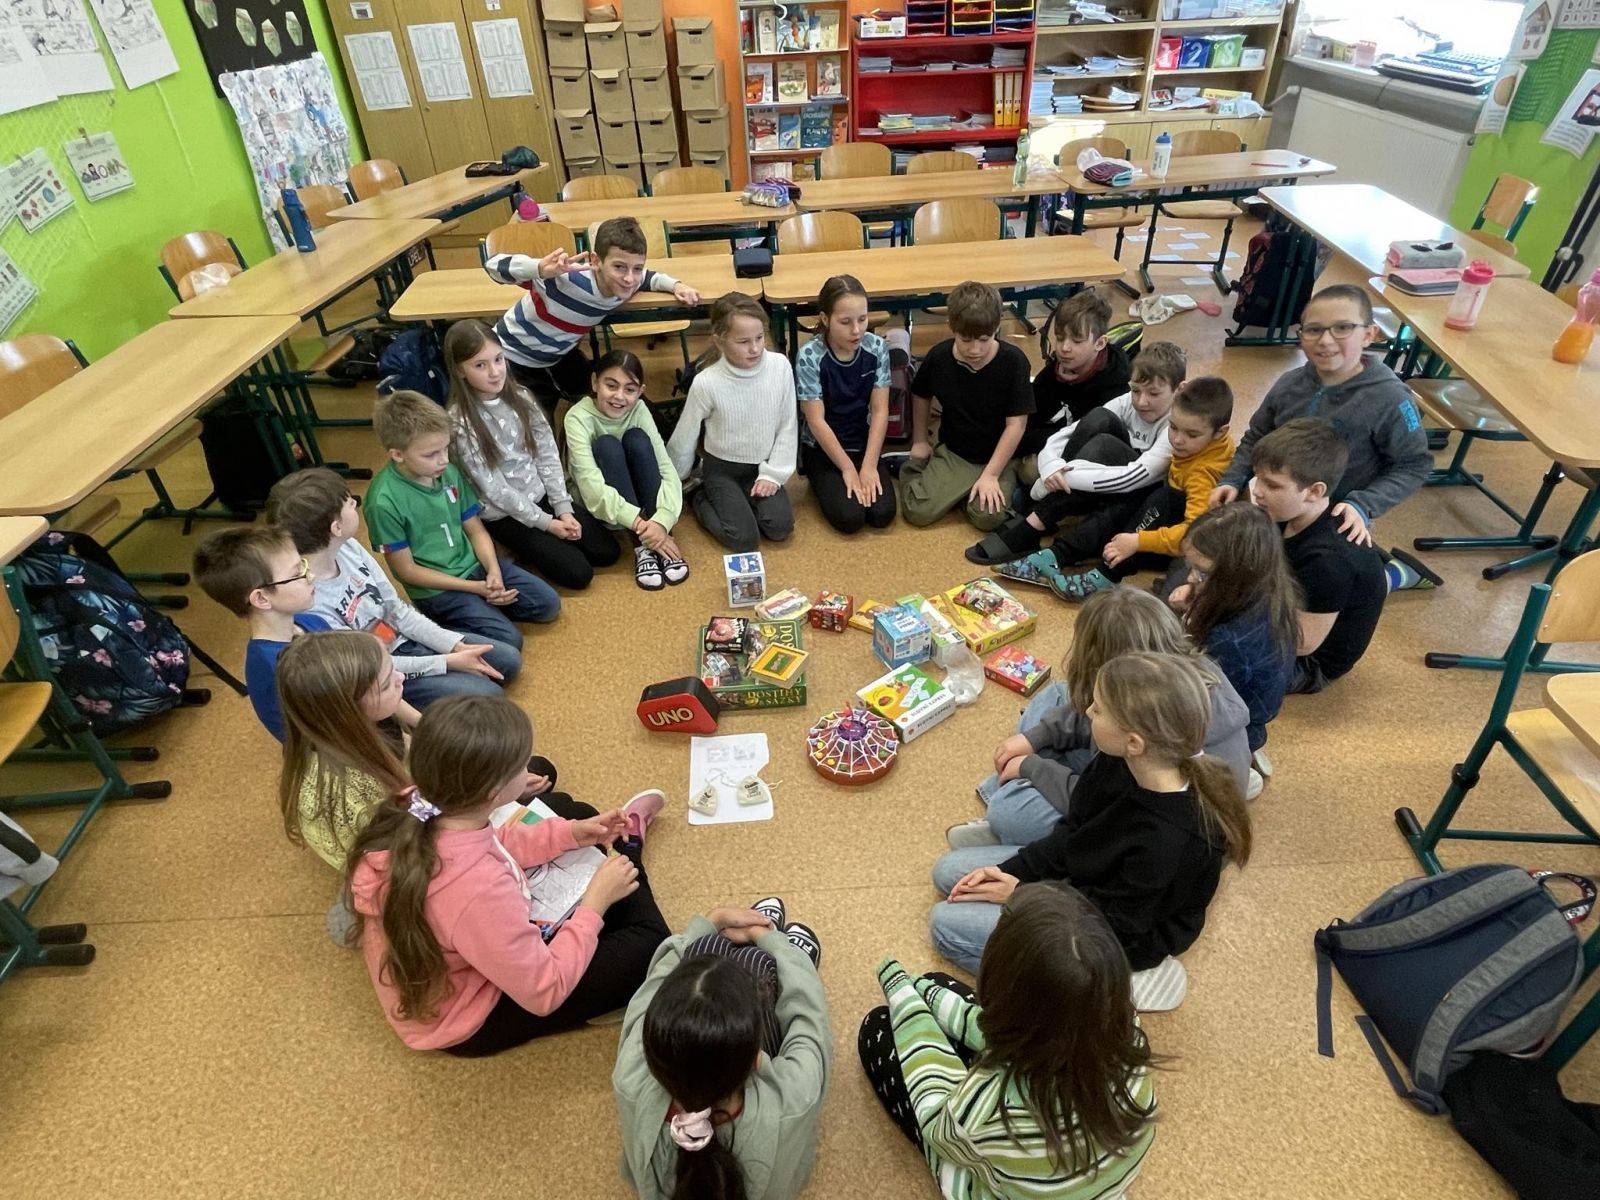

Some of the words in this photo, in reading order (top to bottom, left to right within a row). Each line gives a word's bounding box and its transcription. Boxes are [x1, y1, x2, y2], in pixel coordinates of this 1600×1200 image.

[1185, 41, 1202, 67] 2
[440, 523, 454, 547] 1
[638, 562, 659, 573] FILA
[647, 707, 694, 726] UNO
